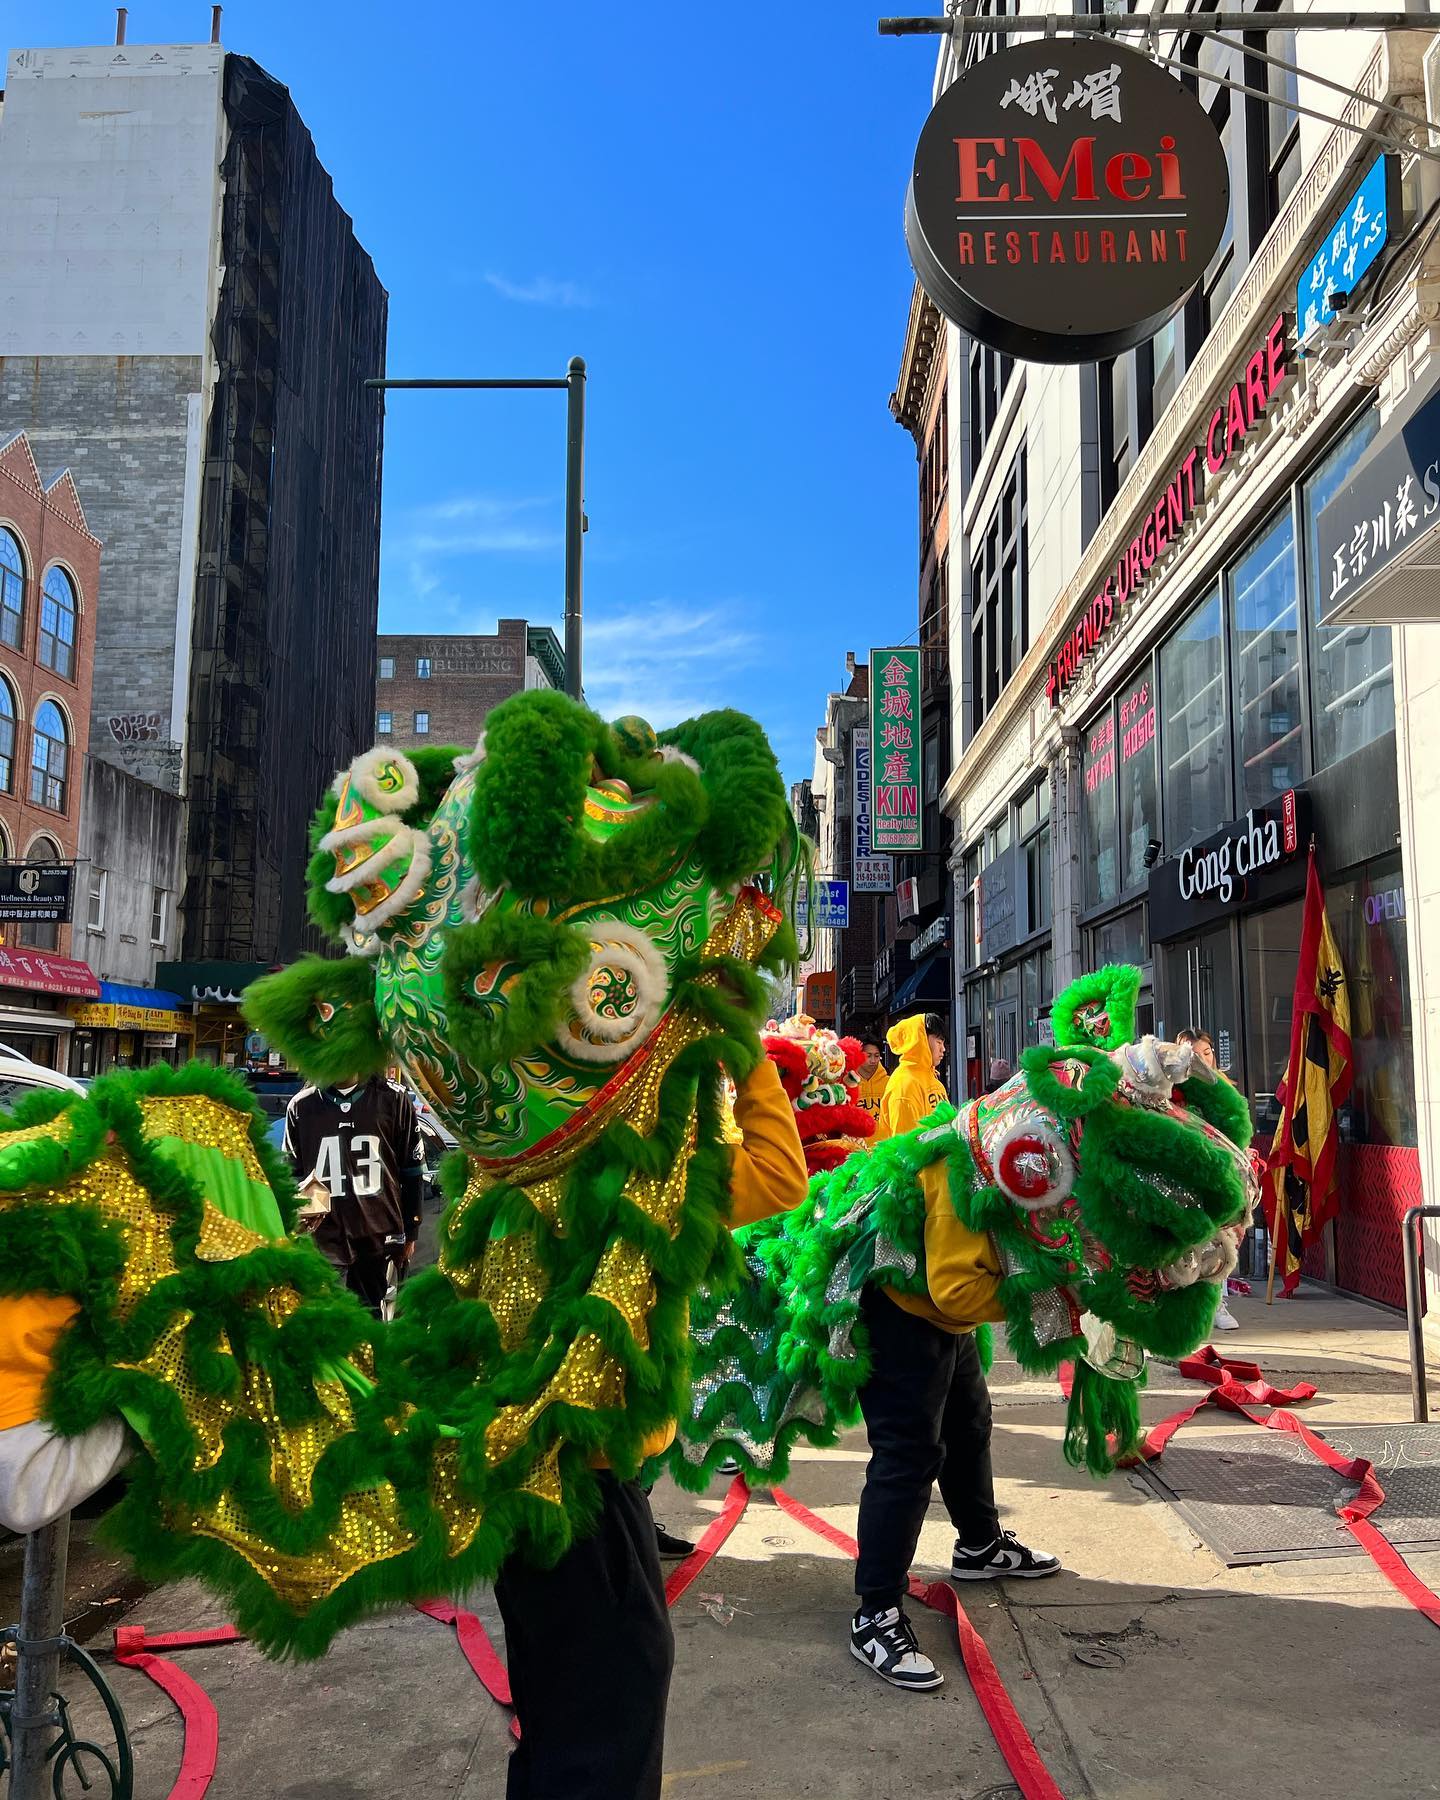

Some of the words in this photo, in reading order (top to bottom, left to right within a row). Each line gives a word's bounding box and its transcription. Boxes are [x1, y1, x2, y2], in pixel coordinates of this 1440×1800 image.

[953, 135, 1187, 202] EMei
[958, 229, 1188, 265] RESTAURANT
[1057, 577, 1114, 690] FRIENDS
[1117, 448, 1198, 604] URGENT
[1206, 312, 1286, 474] CARE
[1329, 475, 1418, 600] 正宗川菜
[434, 660, 512, 672] BUILDING
[880, 656, 913, 783] 金城地產
[876, 785, 917, 816] KIN
[1086, 761, 1100, 795] FAY
[856, 771, 870, 857] DESIGNER
[877, 818, 902, 831] Realty
[903, 818, 918, 829] LLC
[1179, 836, 1232, 903] Gong
[1236, 809, 1280, 876] cha
[34, 895, 52, 904] Beauty
[1365, 887, 1404, 925] OPEN
[316, 1135, 381, 1197] 43
